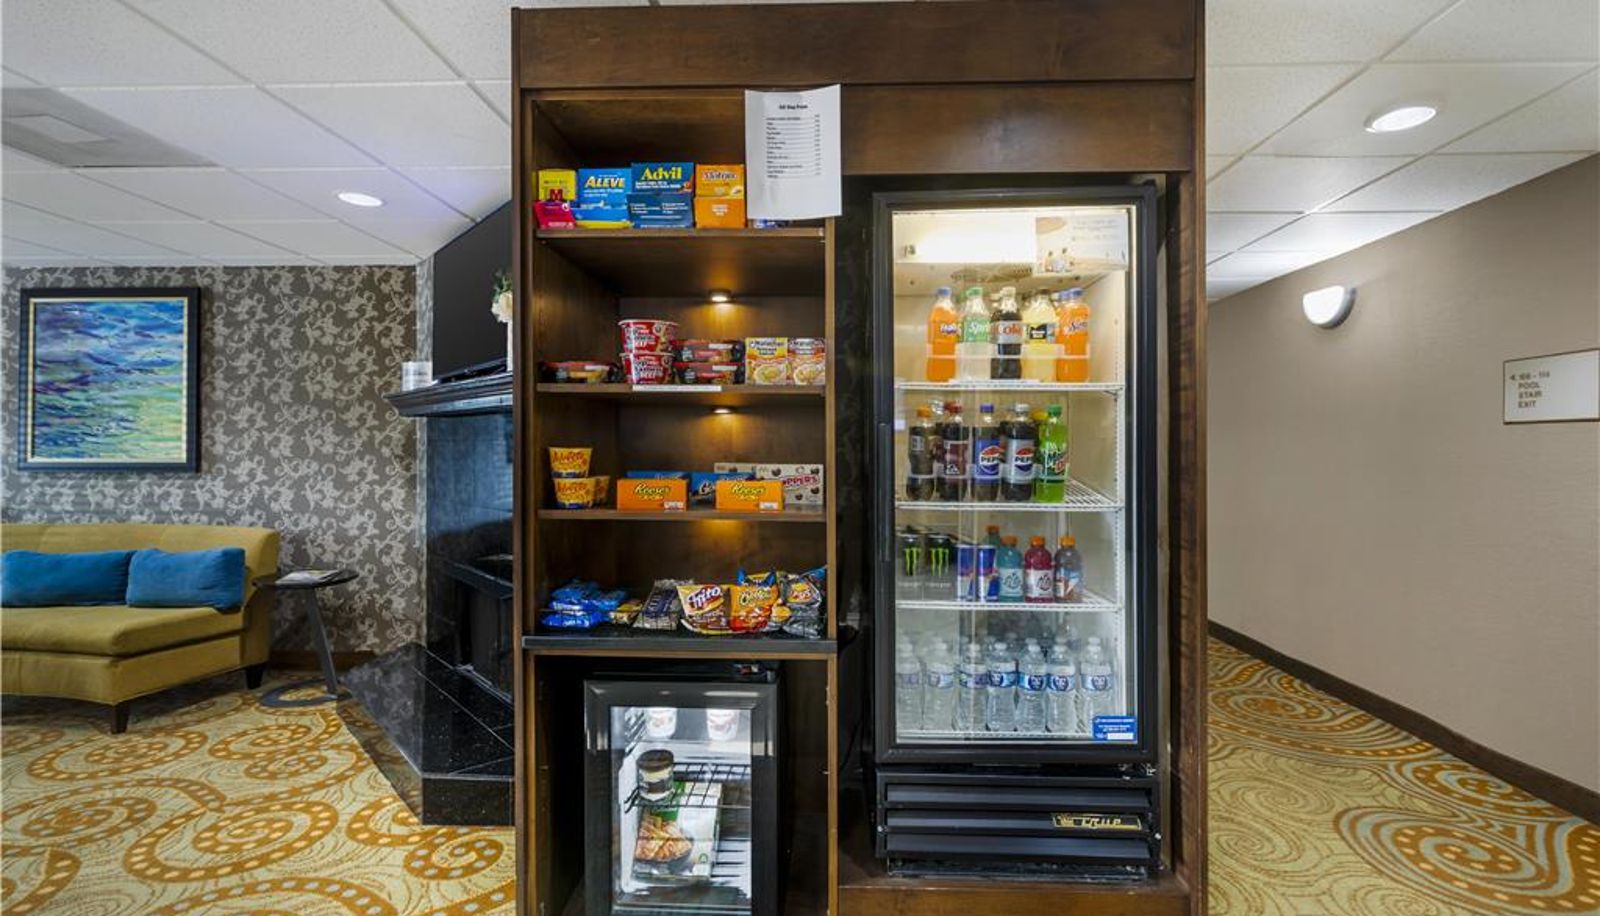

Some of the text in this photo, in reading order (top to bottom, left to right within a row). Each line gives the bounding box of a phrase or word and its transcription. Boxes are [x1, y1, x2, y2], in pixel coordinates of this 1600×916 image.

[641, 166, 683, 181] Advil
[584, 175, 626, 189] ALEVE
[1518, 400, 1537, 408] EXIT
